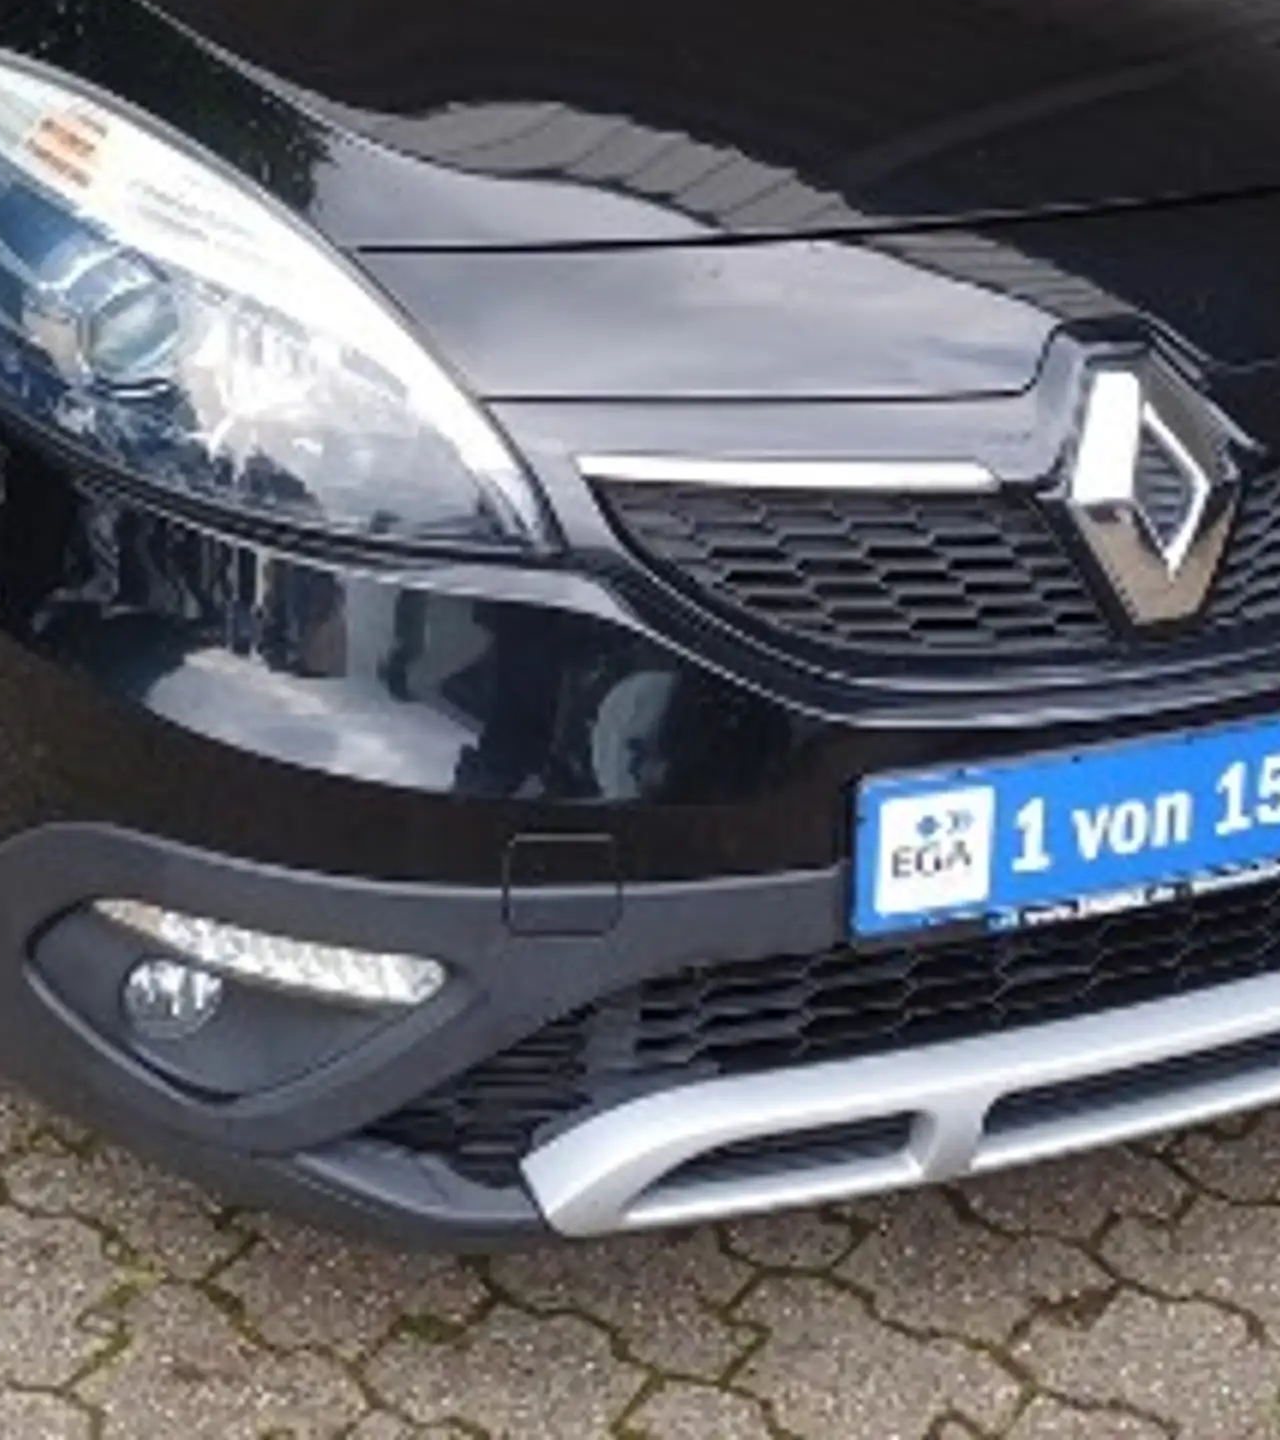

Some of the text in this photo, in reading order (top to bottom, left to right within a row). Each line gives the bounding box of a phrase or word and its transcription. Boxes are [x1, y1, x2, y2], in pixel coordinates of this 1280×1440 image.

[890, 838, 973, 880] EGA
[1009, 795, 1053, 873] 1
[1071, 787, 1194, 862] von
